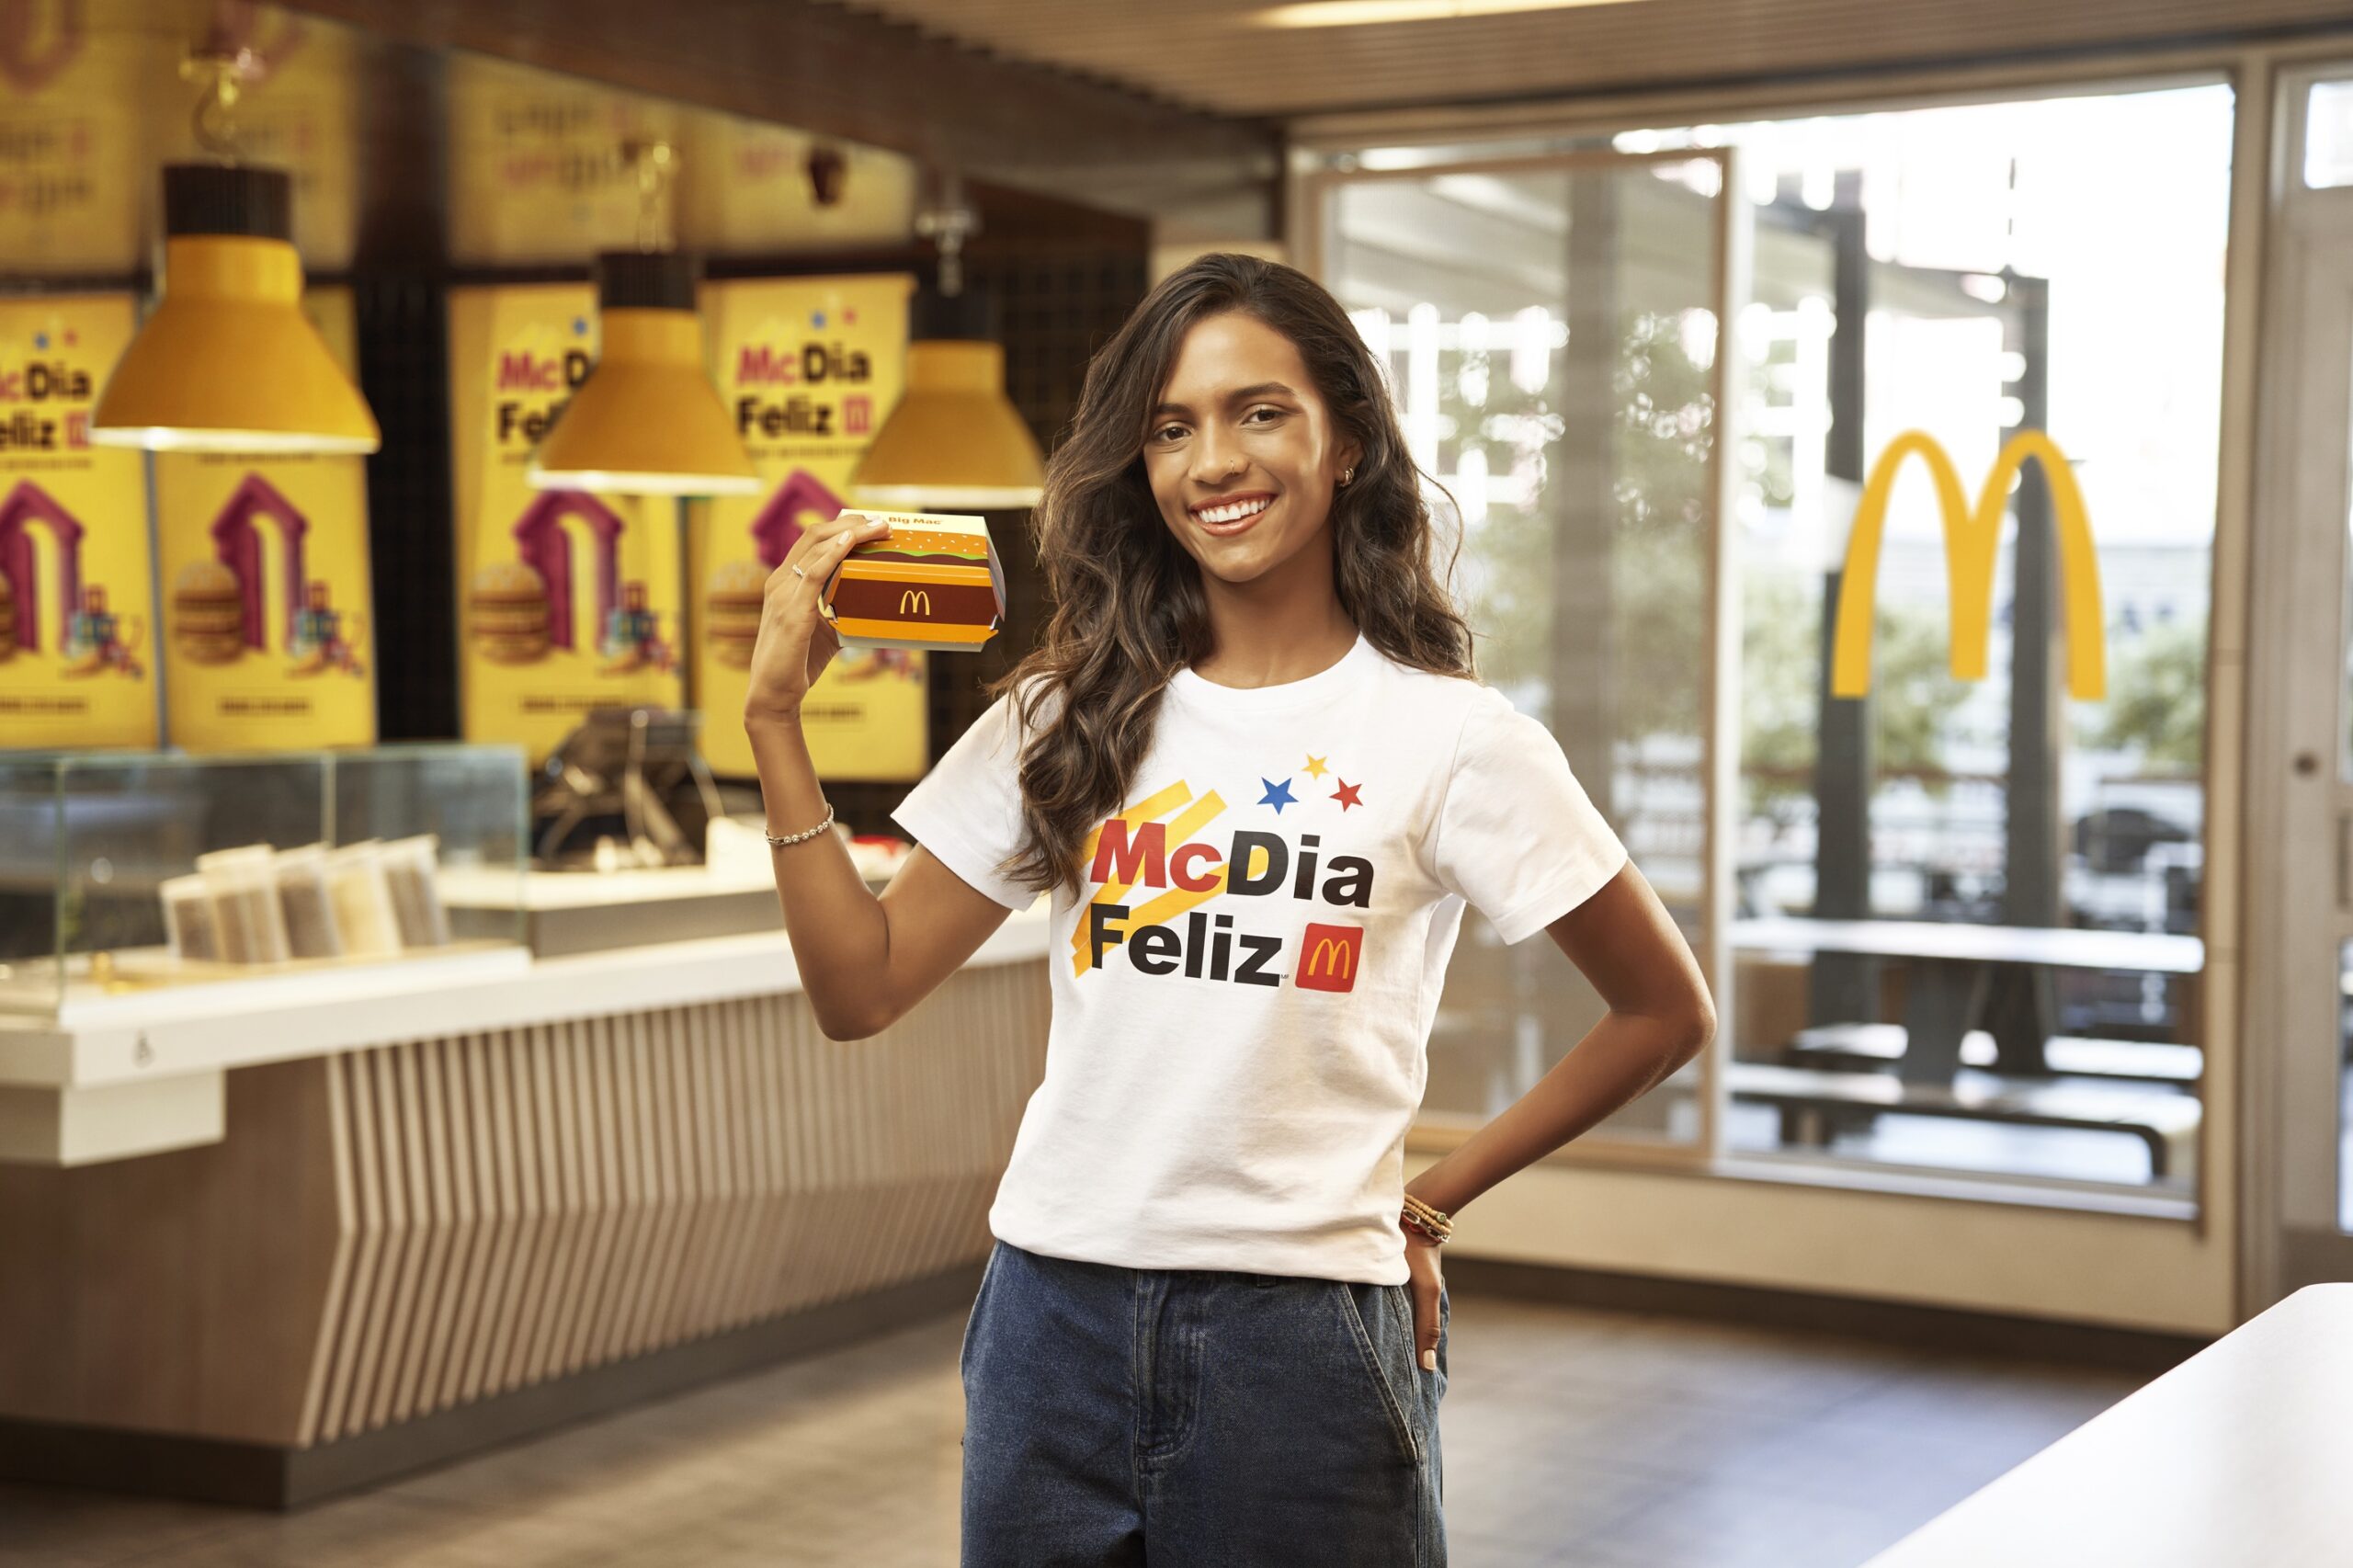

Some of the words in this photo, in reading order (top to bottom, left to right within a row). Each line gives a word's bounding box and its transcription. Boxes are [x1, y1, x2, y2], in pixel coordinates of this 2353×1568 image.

[498, 350, 596, 392] McD
[738, 341, 870, 386] McDia
[738, 396, 833, 438] Feliz
[889, 517, 910, 525] Big
[914, 517, 942, 526] Mac
[1090, 818, 1374, 908] McDia
[1090, 902, 1283, 987] Feliz
